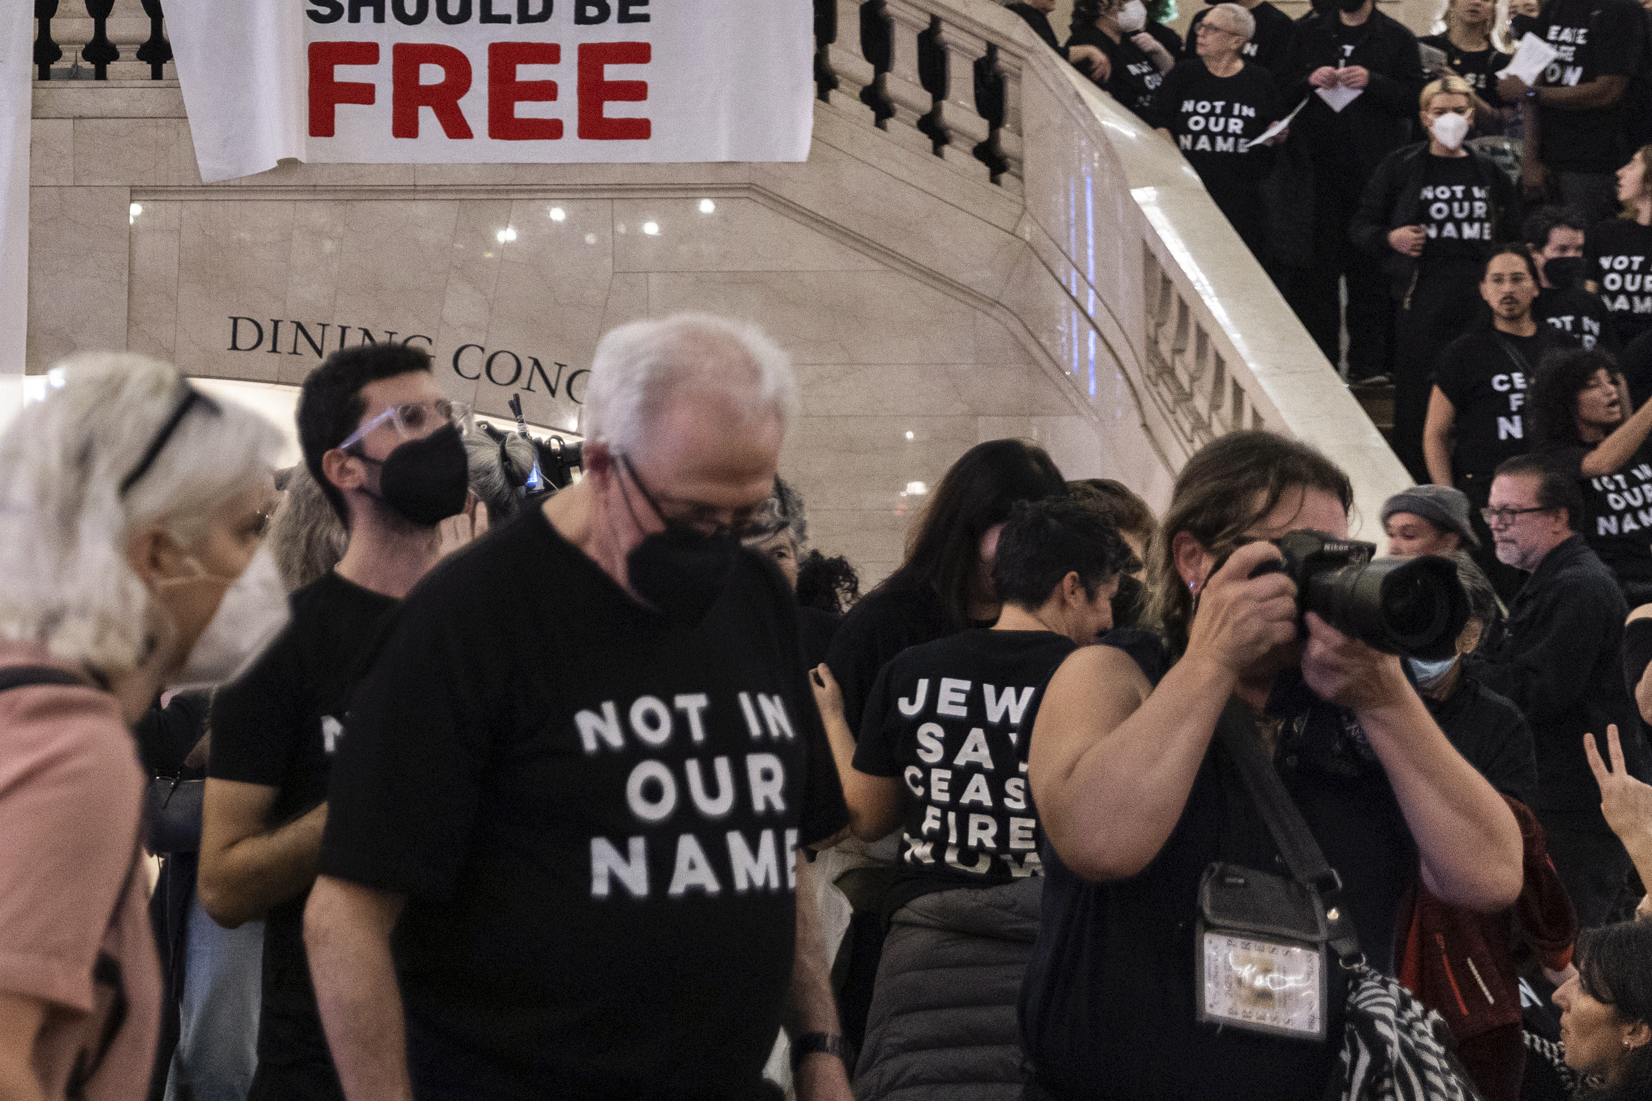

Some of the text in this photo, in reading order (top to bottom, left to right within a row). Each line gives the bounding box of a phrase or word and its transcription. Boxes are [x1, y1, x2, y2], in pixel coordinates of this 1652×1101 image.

[306, 39, 653, 142] FREE
[1180, 98, 1257, 118] NOT IN
[1186, 114, 1245, 135] OUR
[1178, 133, 1251, 155] NAME
[1419, 184, 1467, 201] NOT
[1428, 200, 1488, 221] OUR
[1322, 542, 1350, 553] Nikon
[573, 690, 796, 755] NOT IN
[625, 751, 788, 822] OUR
[921, 804, 1038, 850] FIRE
